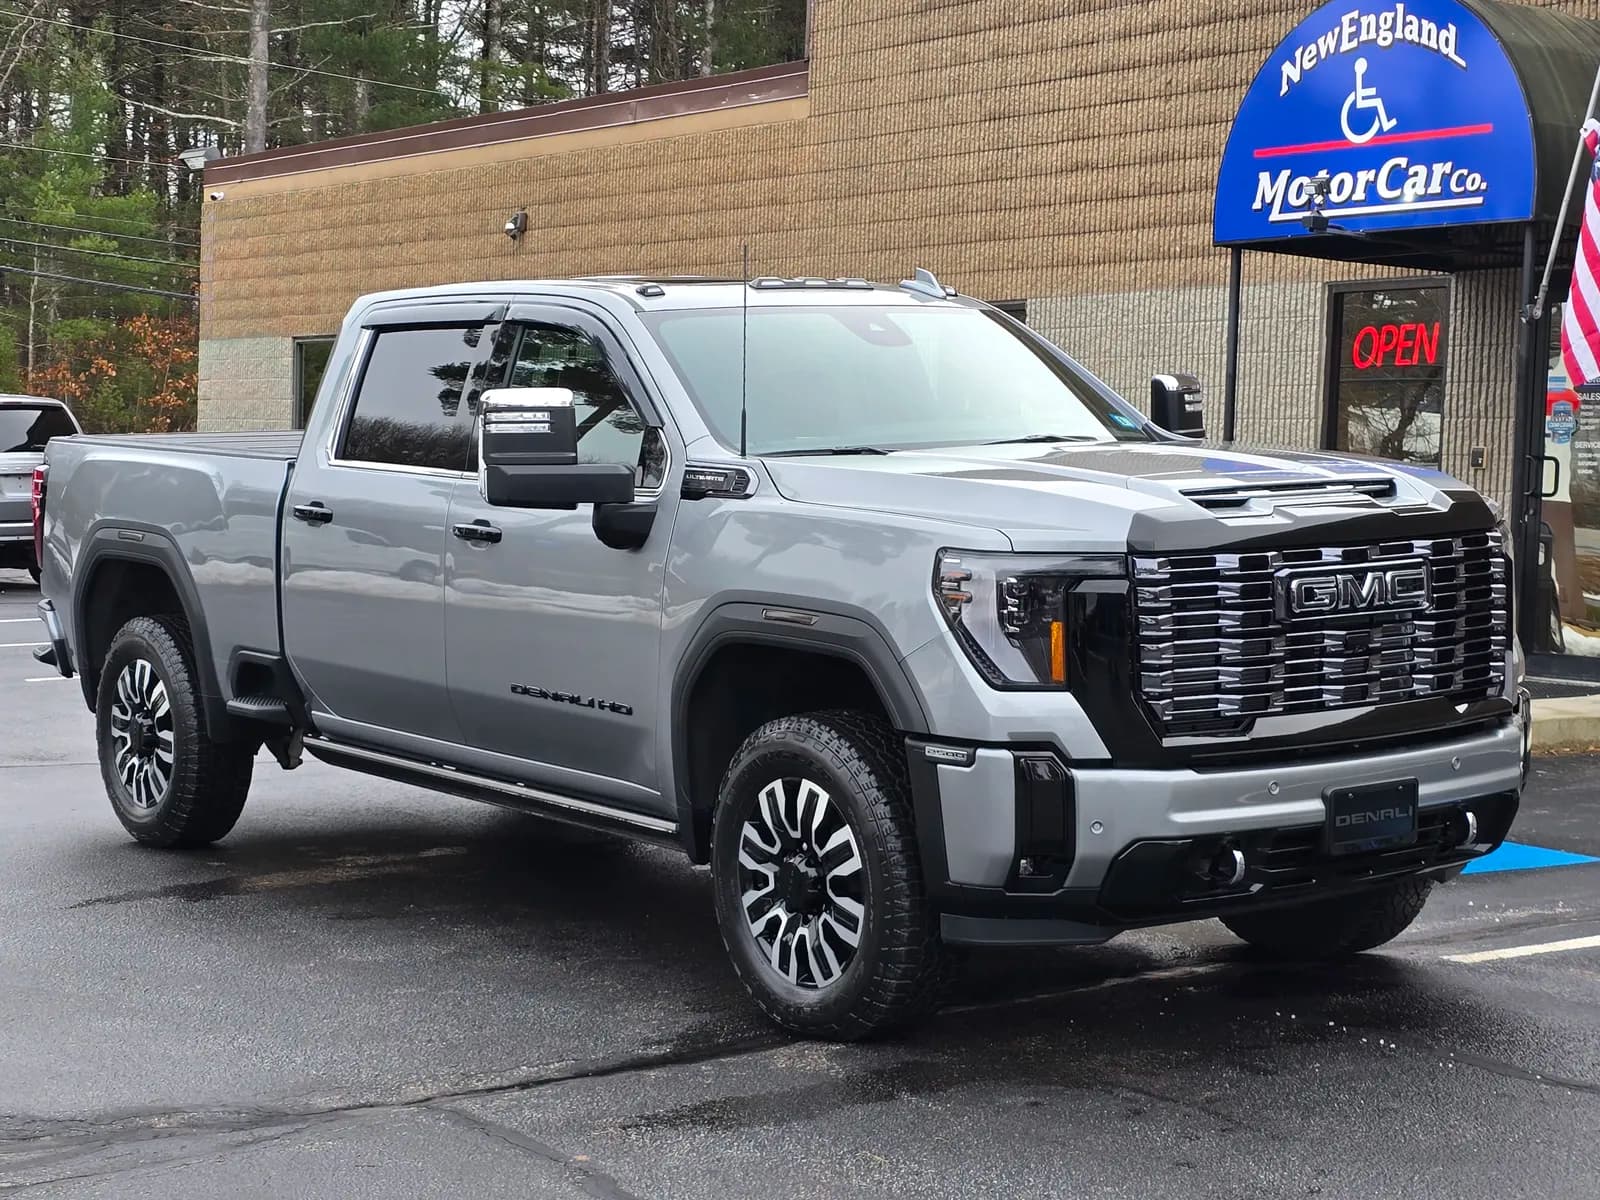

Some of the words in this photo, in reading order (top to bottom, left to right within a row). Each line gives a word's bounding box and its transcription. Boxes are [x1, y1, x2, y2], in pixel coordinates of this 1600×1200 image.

[1450, 168, 1488, 192] Co.
[1352, 321, 1440, 369] OPEN
[1577, 392, 1600, 401] SALES
[1290, 566, 1427, 613] GMC
[510, 682, 595, 709] DENALI
[597, 697, 633, 716] HD
[1335, 805, 1413, 827] DENALI
